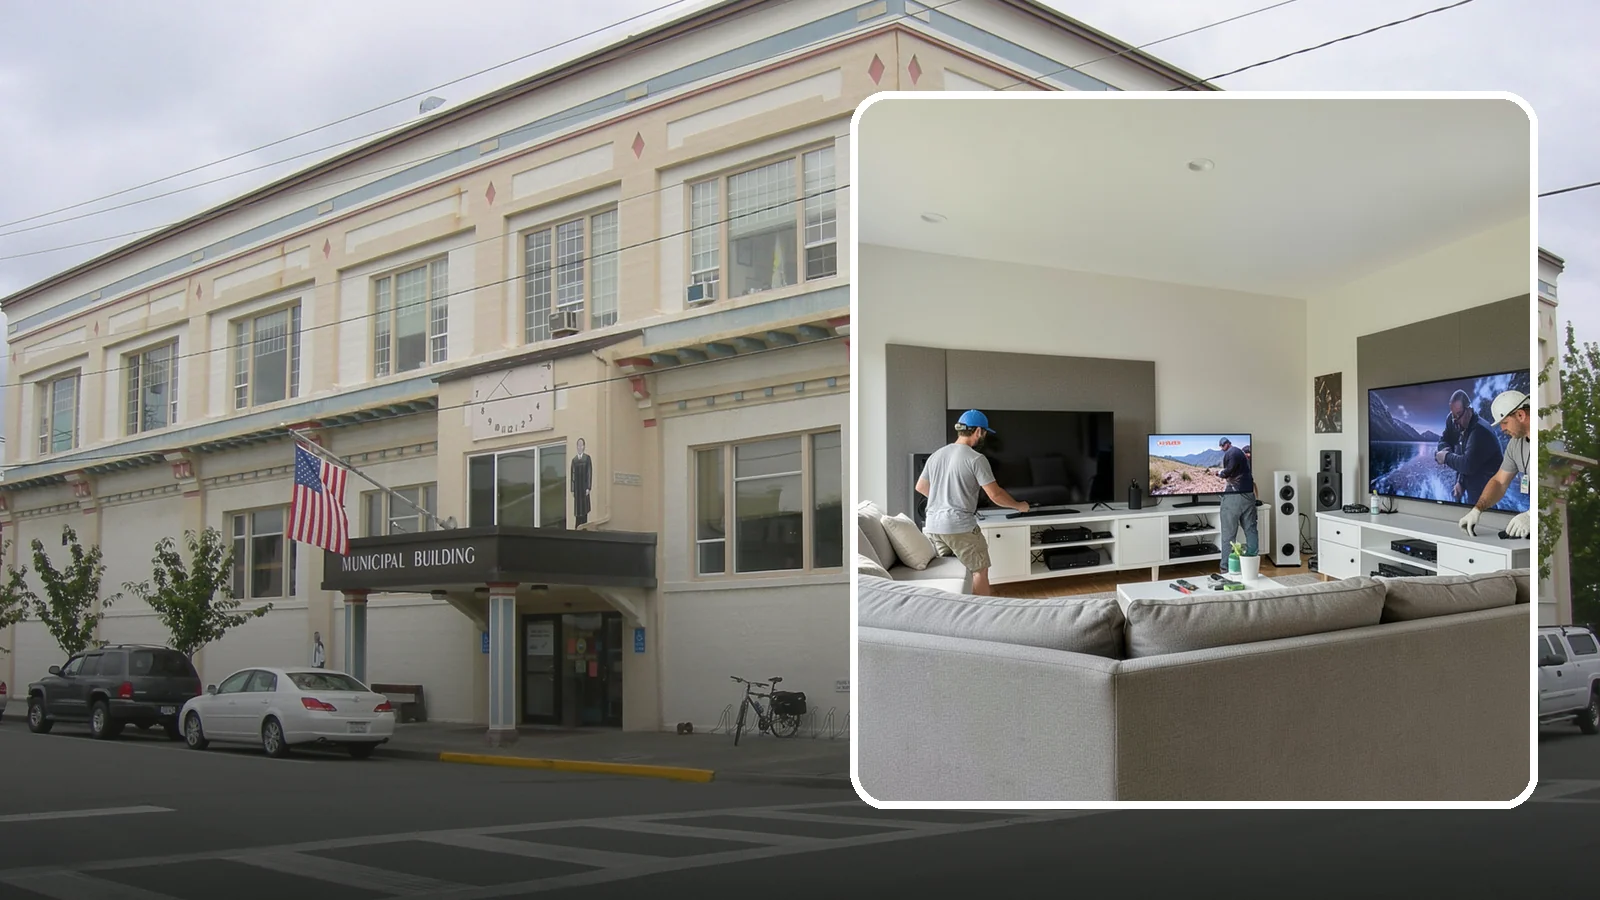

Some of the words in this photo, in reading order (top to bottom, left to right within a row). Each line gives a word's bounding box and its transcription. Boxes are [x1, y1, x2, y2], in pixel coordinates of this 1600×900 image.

[521, 420, 526, 428] 2
[507, 425, 513, 433] 12
[342, 553, 405, 571] MUNICIPAL
[414, 547, 475, 567] BUILDING
